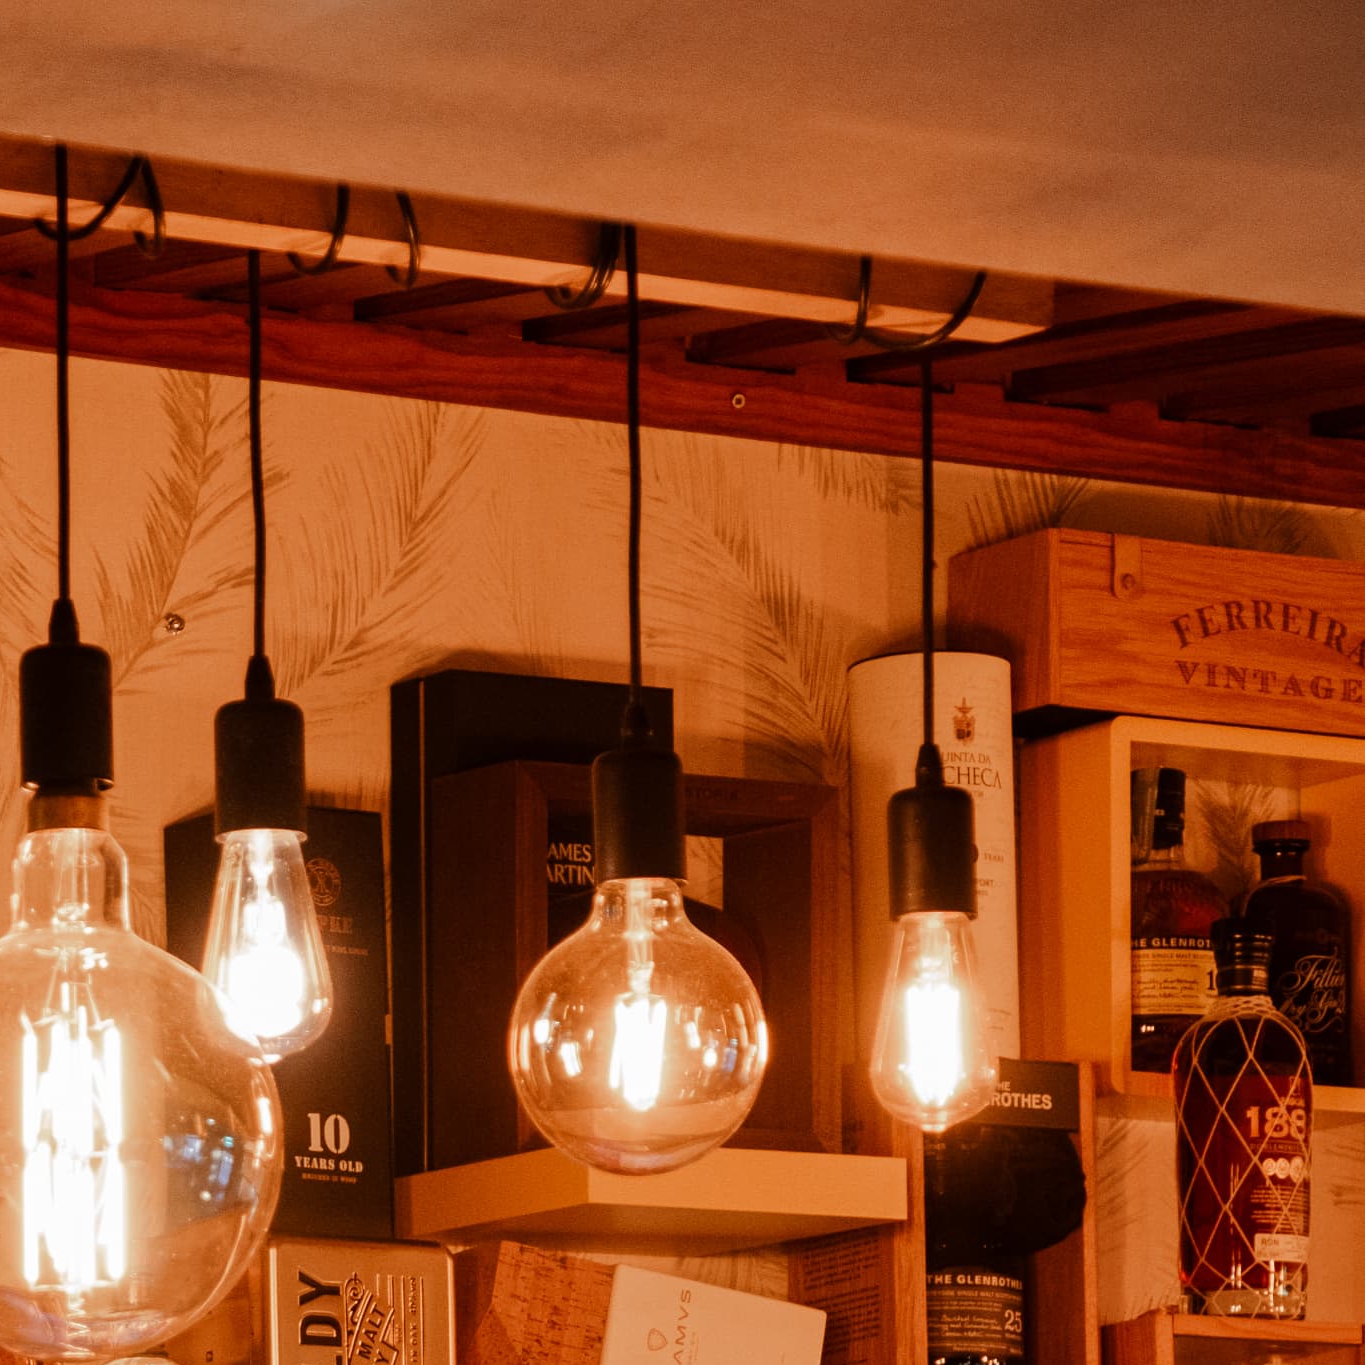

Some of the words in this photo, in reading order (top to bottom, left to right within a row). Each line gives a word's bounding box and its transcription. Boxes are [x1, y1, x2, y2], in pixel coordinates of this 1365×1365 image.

[1175, 660, 1363, 703] VINTAGE
[307, 1113, 350, 1154] 10
[294, 1156, 336, 1170] YEARS
[340, 1159, 363, 1173] OLD
[361, 1304, 386, 1360] MALT
[1004, 1309, 1022, 1333] 25
